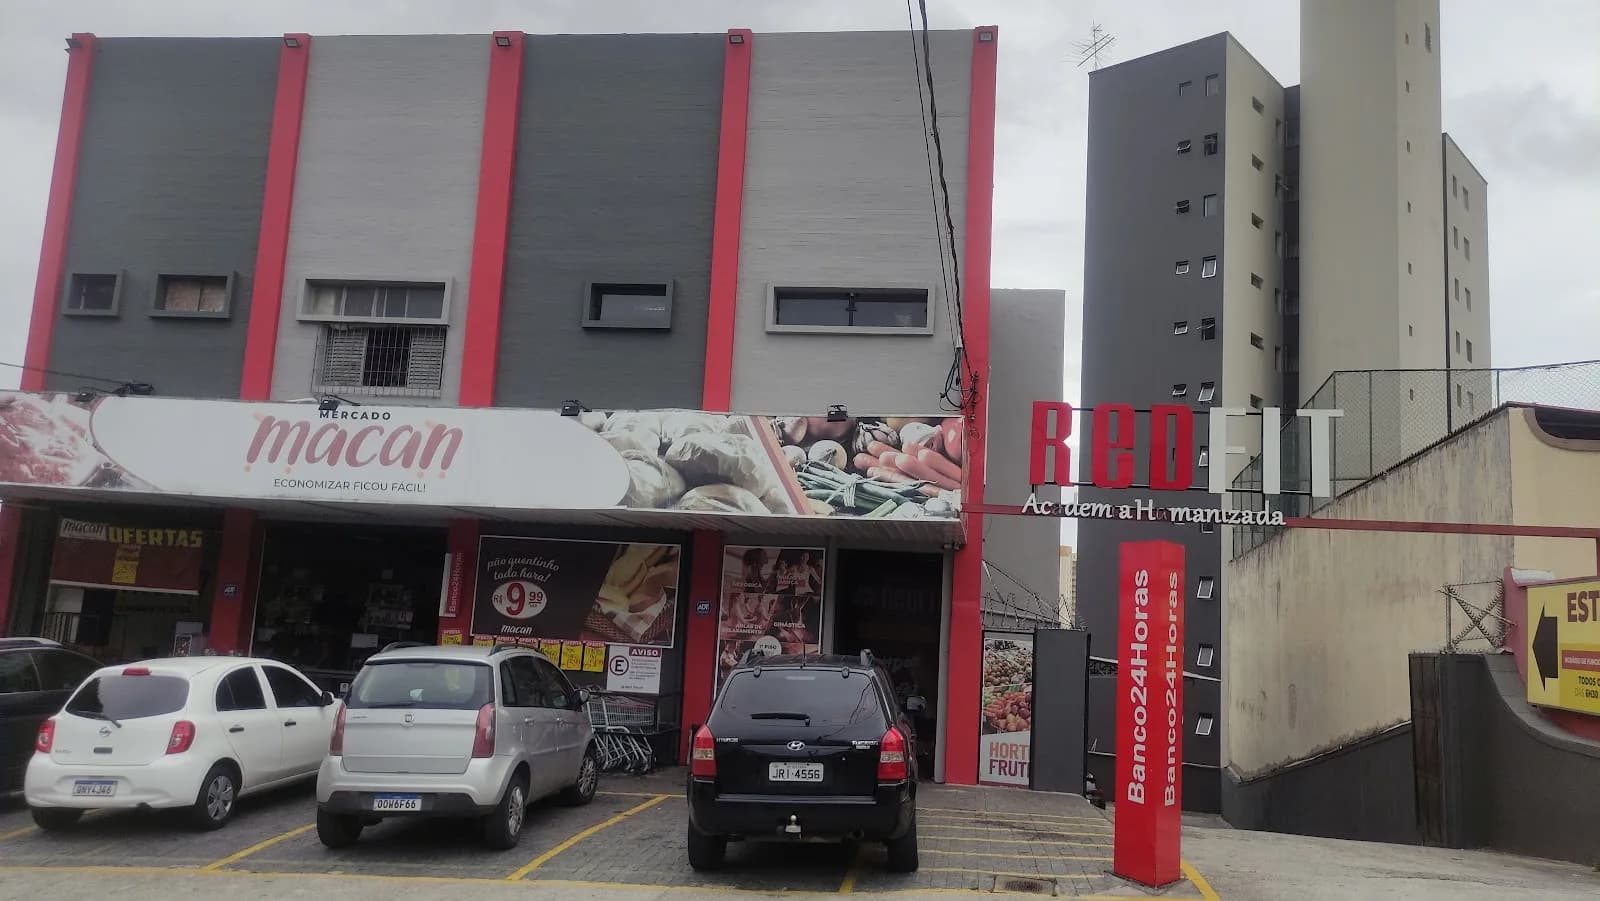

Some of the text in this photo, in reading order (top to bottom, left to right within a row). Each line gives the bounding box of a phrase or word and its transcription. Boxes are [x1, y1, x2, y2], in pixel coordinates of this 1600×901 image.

[319, 410, 391, 421] MERCADO
[245, 413, 464, 479] macan
[274, 478, 426, 493] ECONOMIZAR FICOU FÁCIL!
[108, 527, 203, 548] OFERTAS
[487, 556, 560, 572] pão quentinho
[519, 567, 551, 583] hora!
[506, 582, 526, 616] 9
[529, 591, 544, 602] 99
[1567, 590, 1600, 623] EST
[501, 624, 533, 635] macan
[615, 659, 624, 672] E
[1127, 569, 1149, 804] Banco24Horas
[1164, 571, 1178, 806] Banco24Horas
[1578, 675, 1596, 686] TODOS
